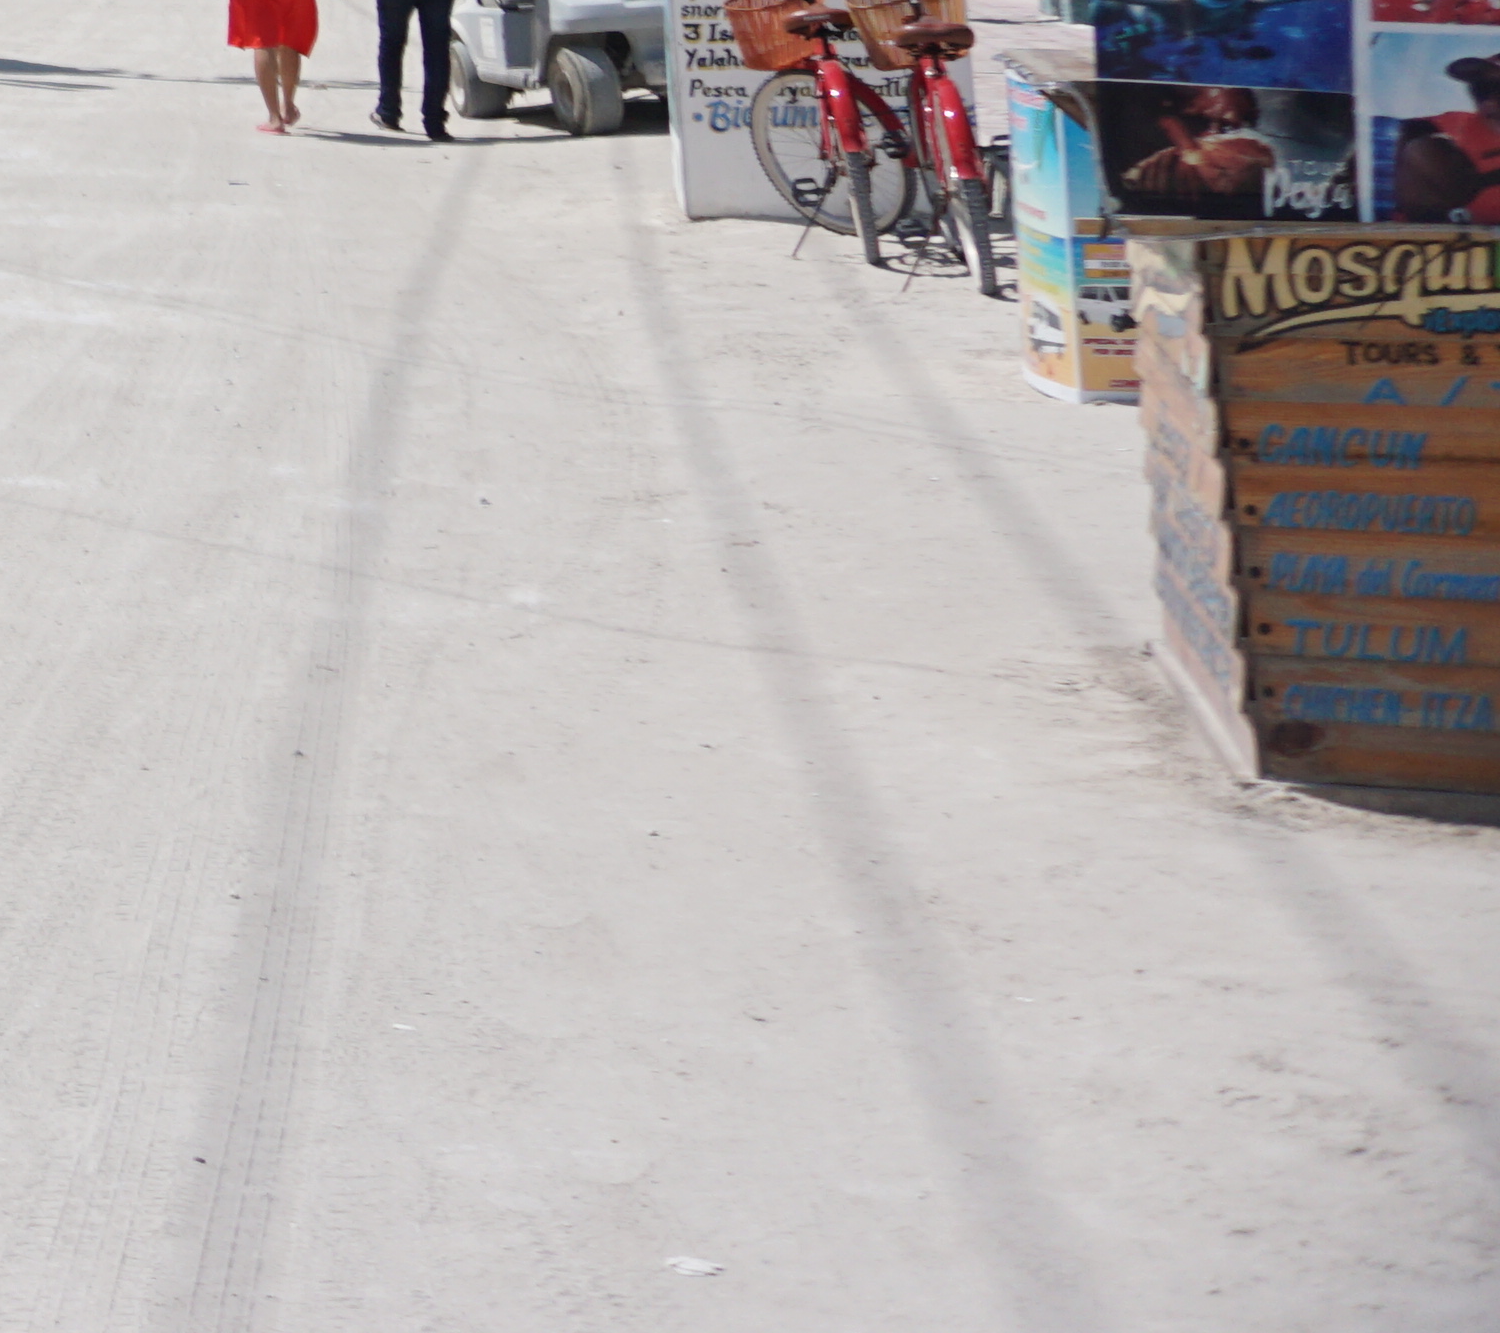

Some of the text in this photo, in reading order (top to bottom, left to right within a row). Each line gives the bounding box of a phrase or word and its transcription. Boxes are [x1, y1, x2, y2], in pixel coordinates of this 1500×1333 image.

[683, 23, 701, 42] 3
[689, 78, 747, 99] Pesca
[1220, 236, 1500, 326] Mosqui
[1340, 339, 1481, 366] TOURS &
[1258, 423, 1429, 470] CANCUN
[1267, 551, 1348, 595] PLAYA
[1284, 618, 1469, 664] TULUM
